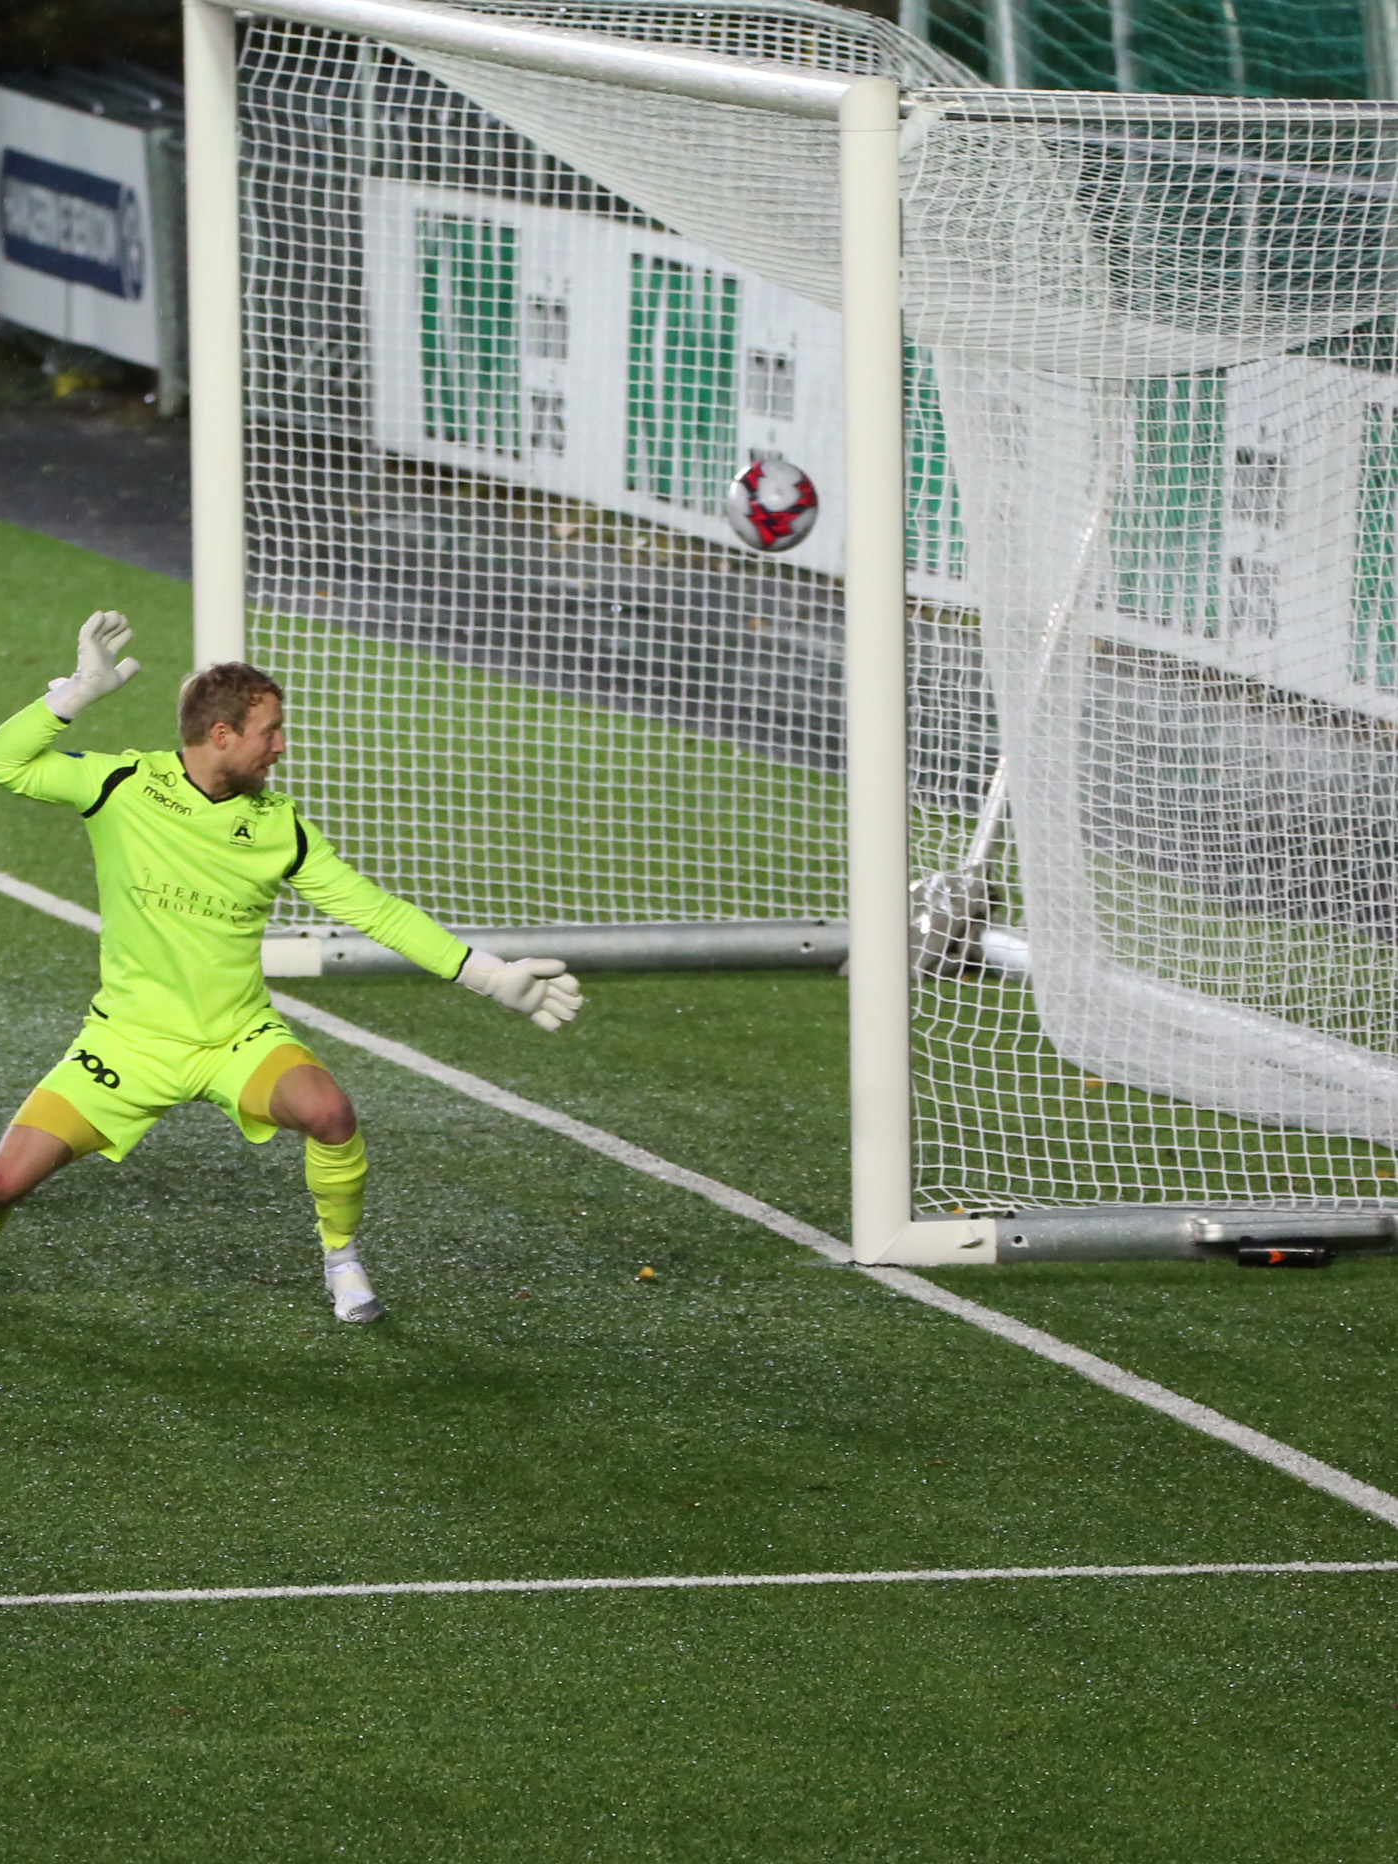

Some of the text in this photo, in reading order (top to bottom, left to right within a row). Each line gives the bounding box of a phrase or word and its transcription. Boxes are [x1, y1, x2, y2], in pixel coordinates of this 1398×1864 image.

[143, 786, 192, 816] macron
[158, 898, 239, 924] HOLDIN
[161, 883, 248, 912] TERTNE
[69, 1049, 121, 1089] oop
